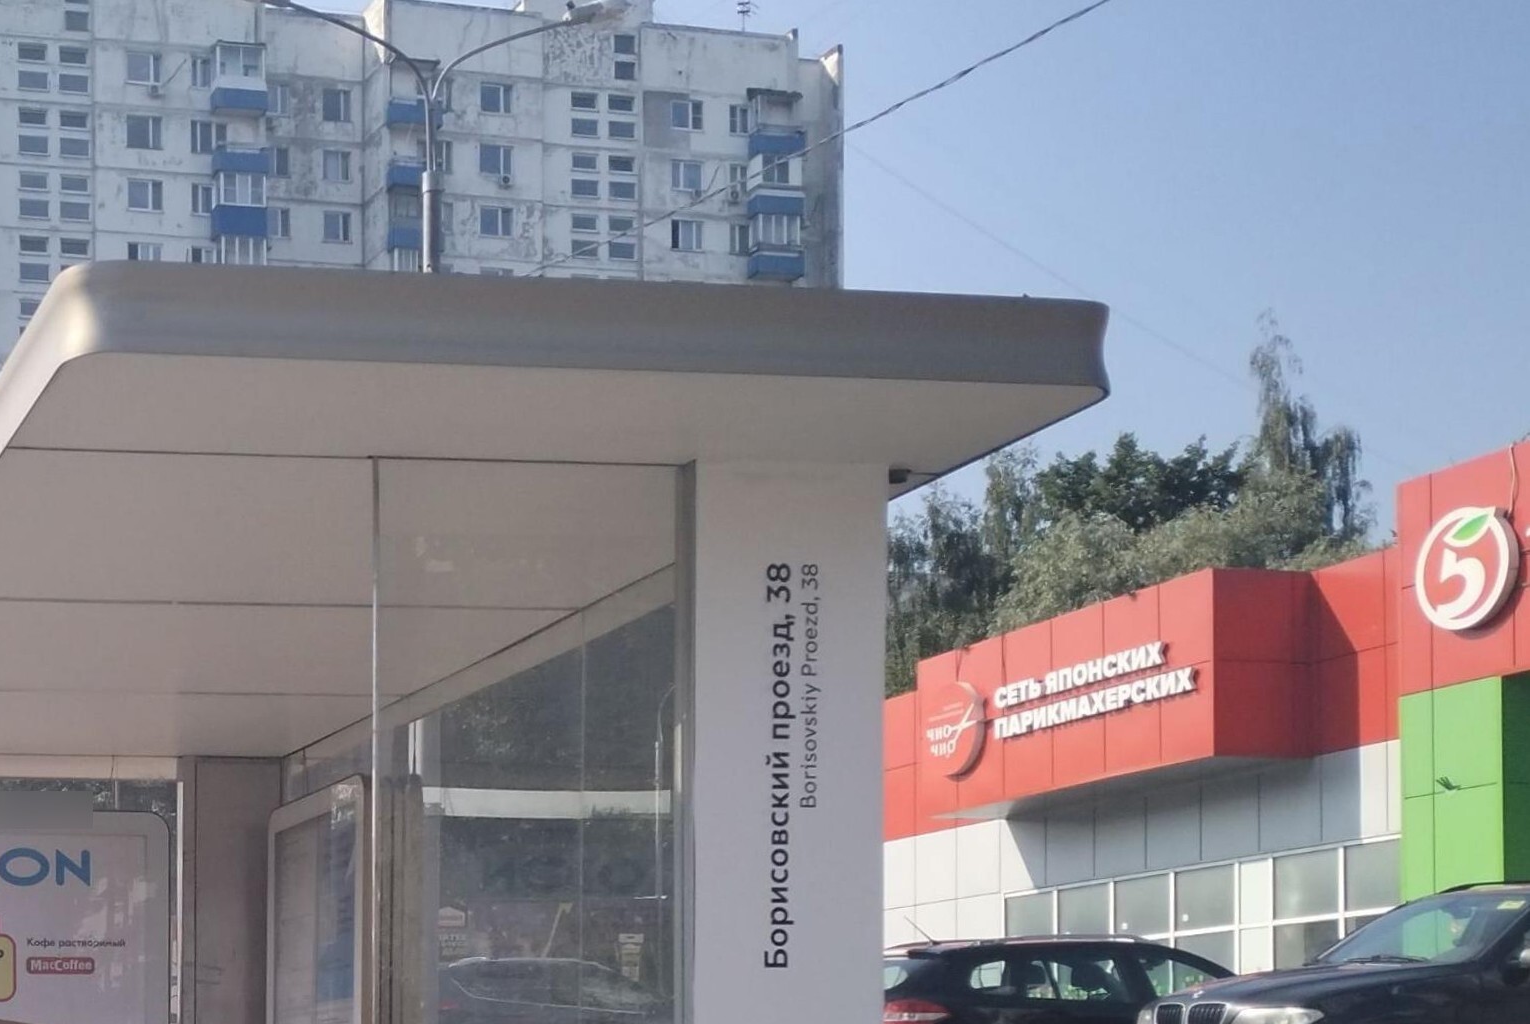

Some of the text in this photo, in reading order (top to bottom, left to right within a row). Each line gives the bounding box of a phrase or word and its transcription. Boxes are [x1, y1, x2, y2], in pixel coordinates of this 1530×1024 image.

[1435, 540, 1487, 625] 5
[800, 563, 821, 808] Borisovskiy Proezd, 38
[994, 641, 1167, 709] СЕТЬ ЯПОНСКИХ
[994, 666, 1197, 740] ПАРИКМАХЕРСКИХ
[764, 562, 796, 969] Борисовский проезд, 38
[26, 937, 126, 948] Кофе растворимый
[30, 959, 93, 971] MacCoffee
